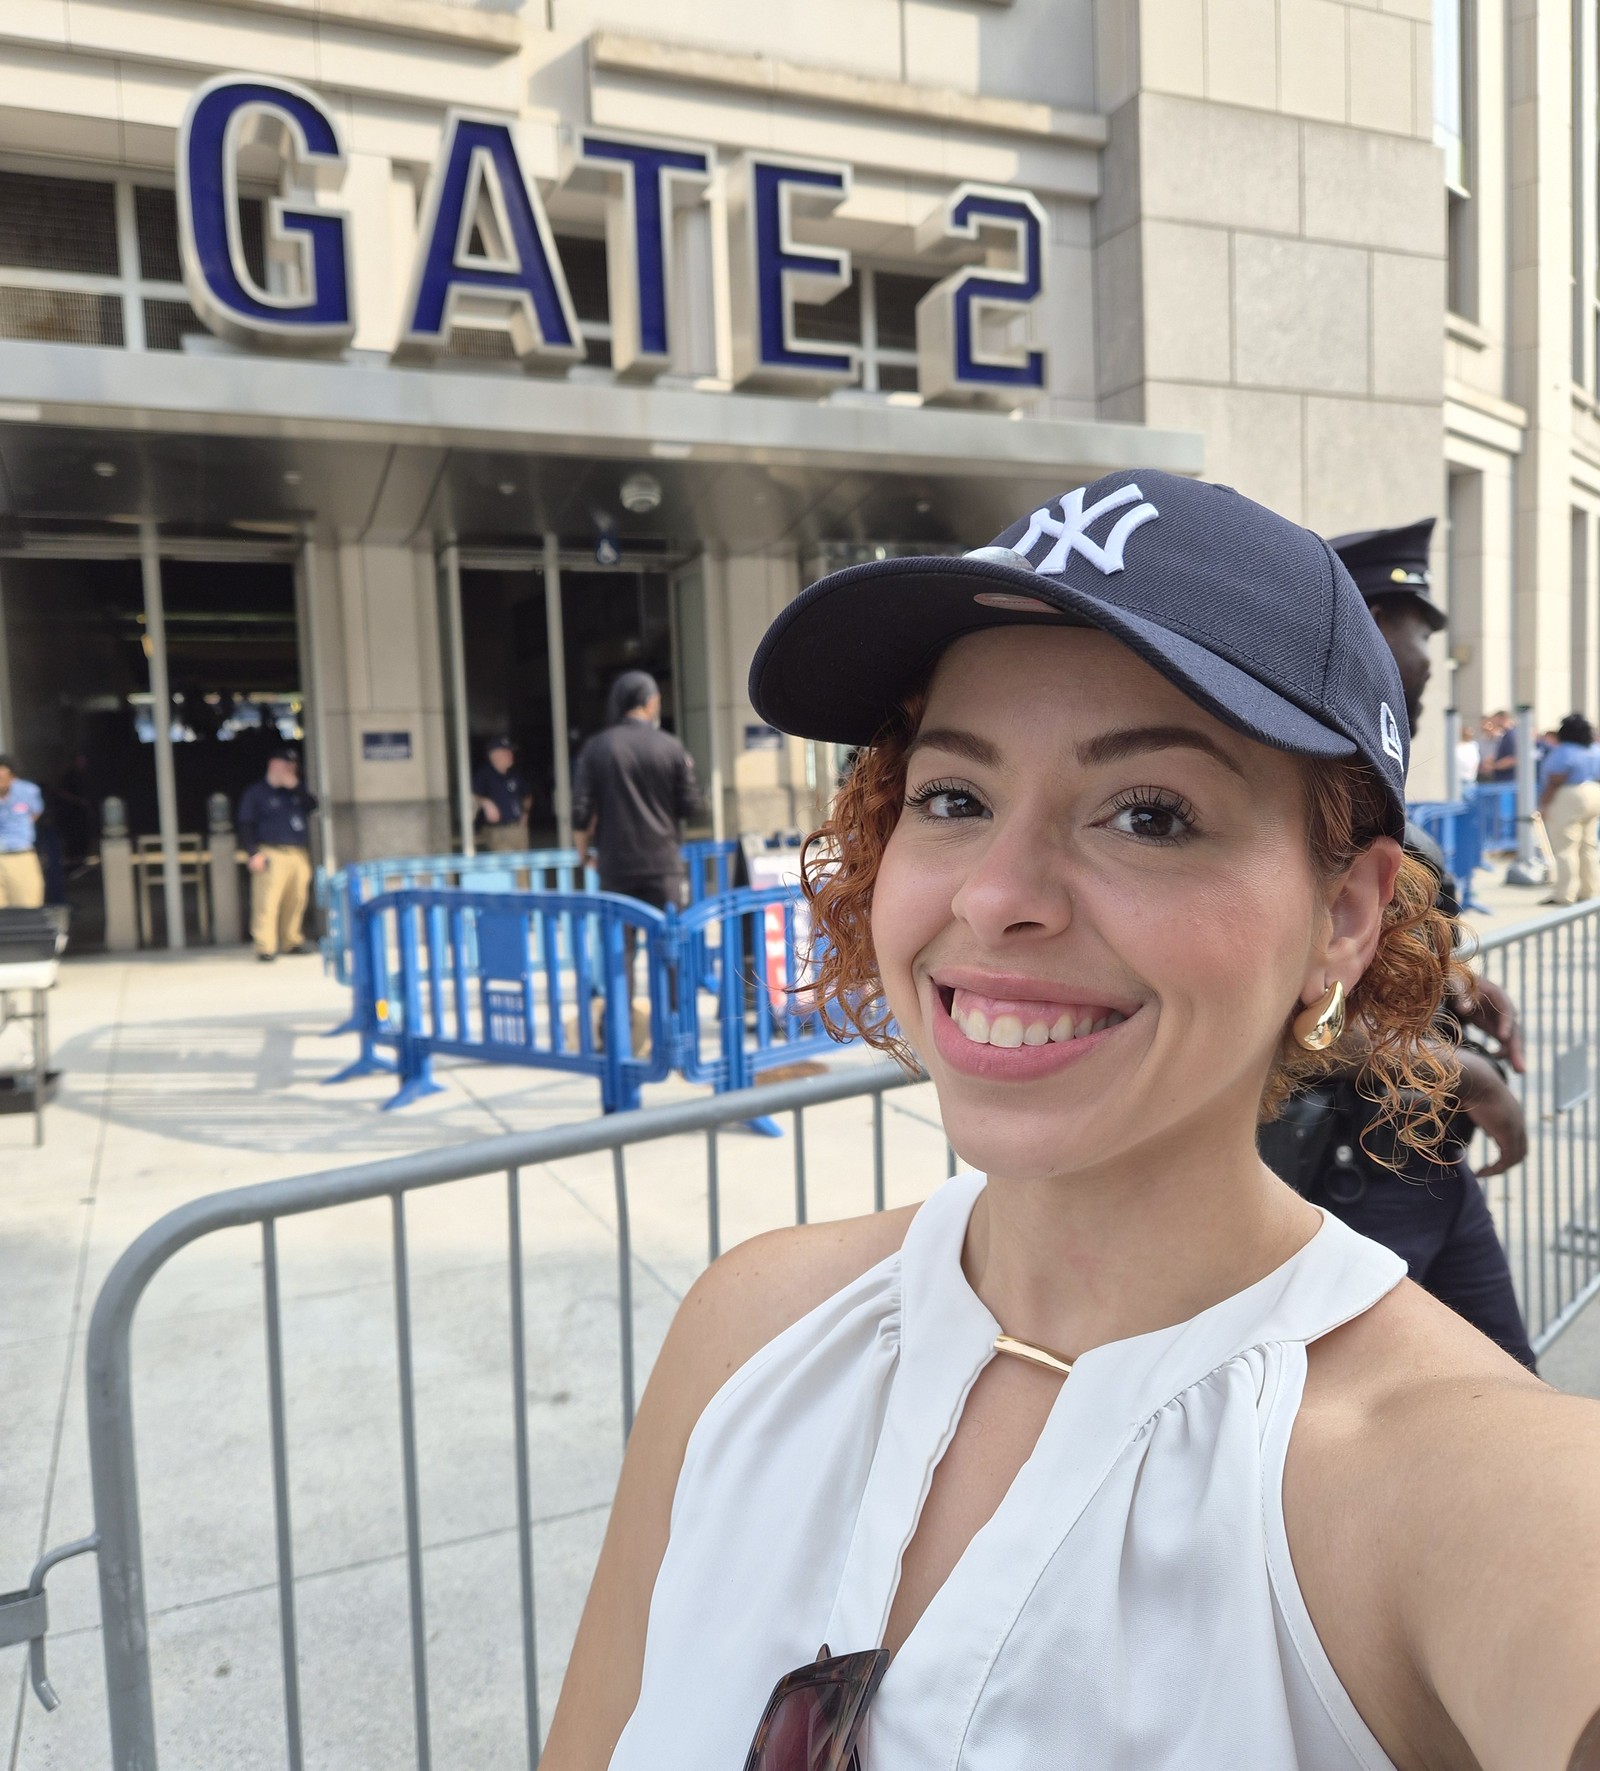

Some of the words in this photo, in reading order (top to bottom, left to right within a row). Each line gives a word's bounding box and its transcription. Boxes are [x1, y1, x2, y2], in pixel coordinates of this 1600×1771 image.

[178, 73, 857, 385] GATE
[946, 184, 1050, 395] 2
[1011, 483, 1159, 575] NY
